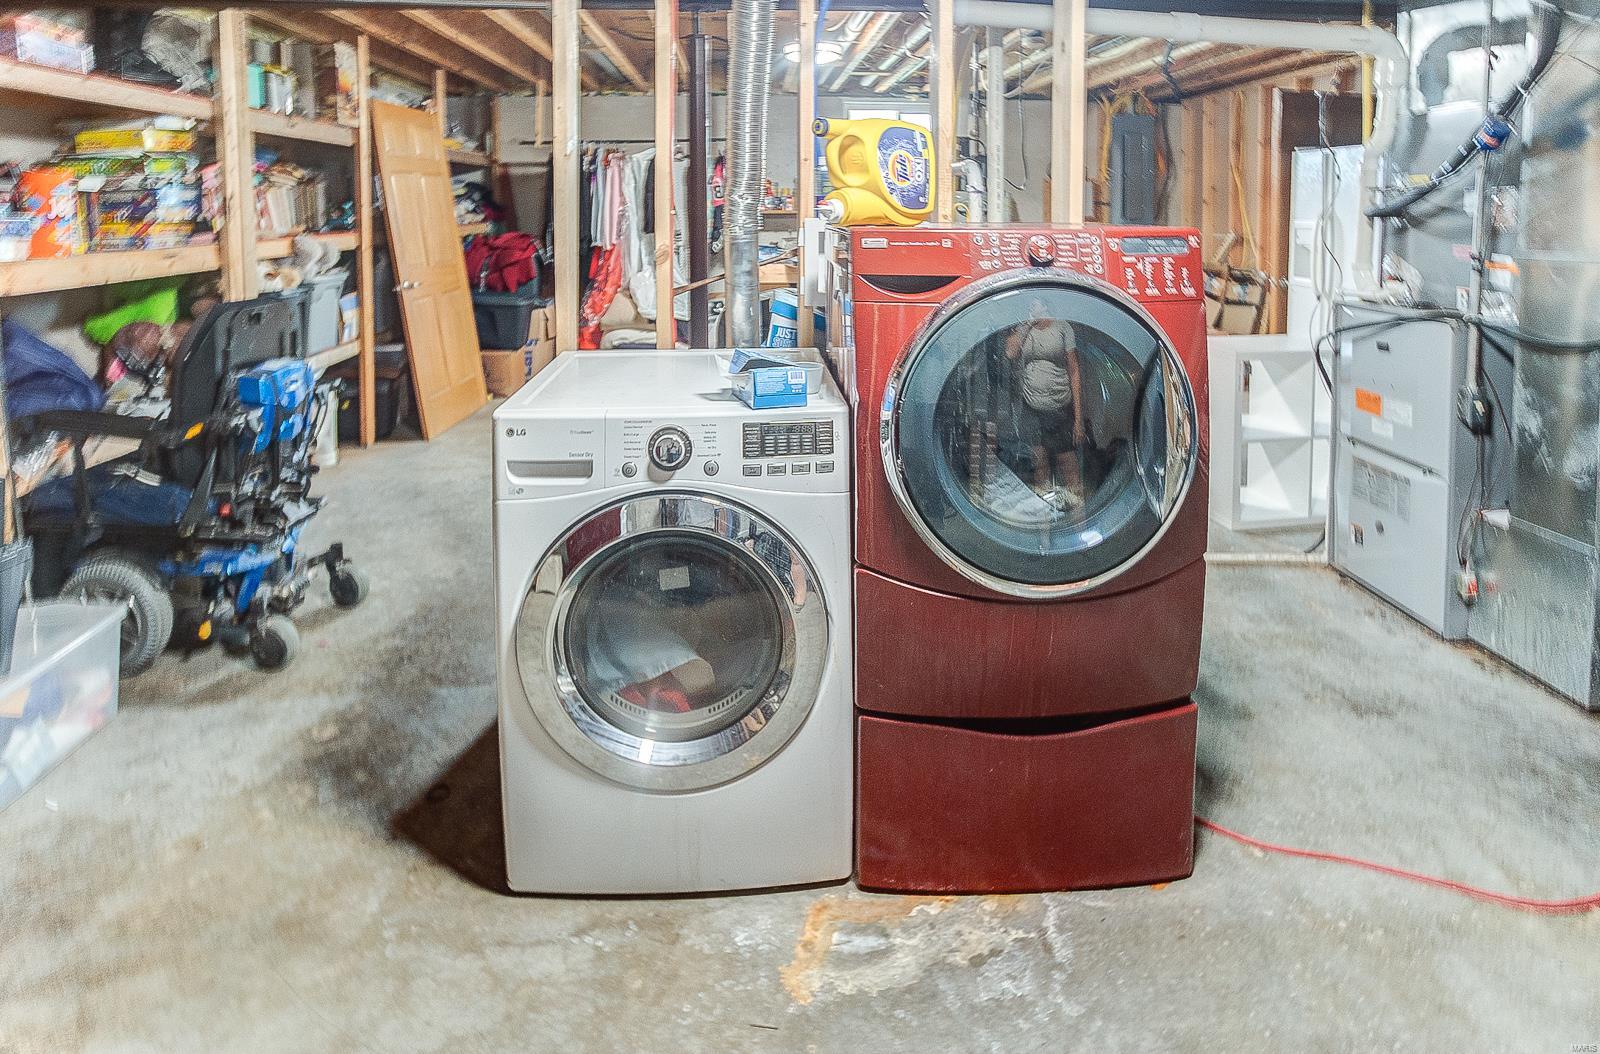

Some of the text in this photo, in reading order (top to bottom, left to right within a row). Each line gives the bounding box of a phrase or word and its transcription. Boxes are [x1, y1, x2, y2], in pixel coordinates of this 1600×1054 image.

[895, 154, 911, 183] Tide
[775, 326, 797, 340] JUST
[516, 428, 527, 437] LG
[584, 451, 594, 459] Dry
